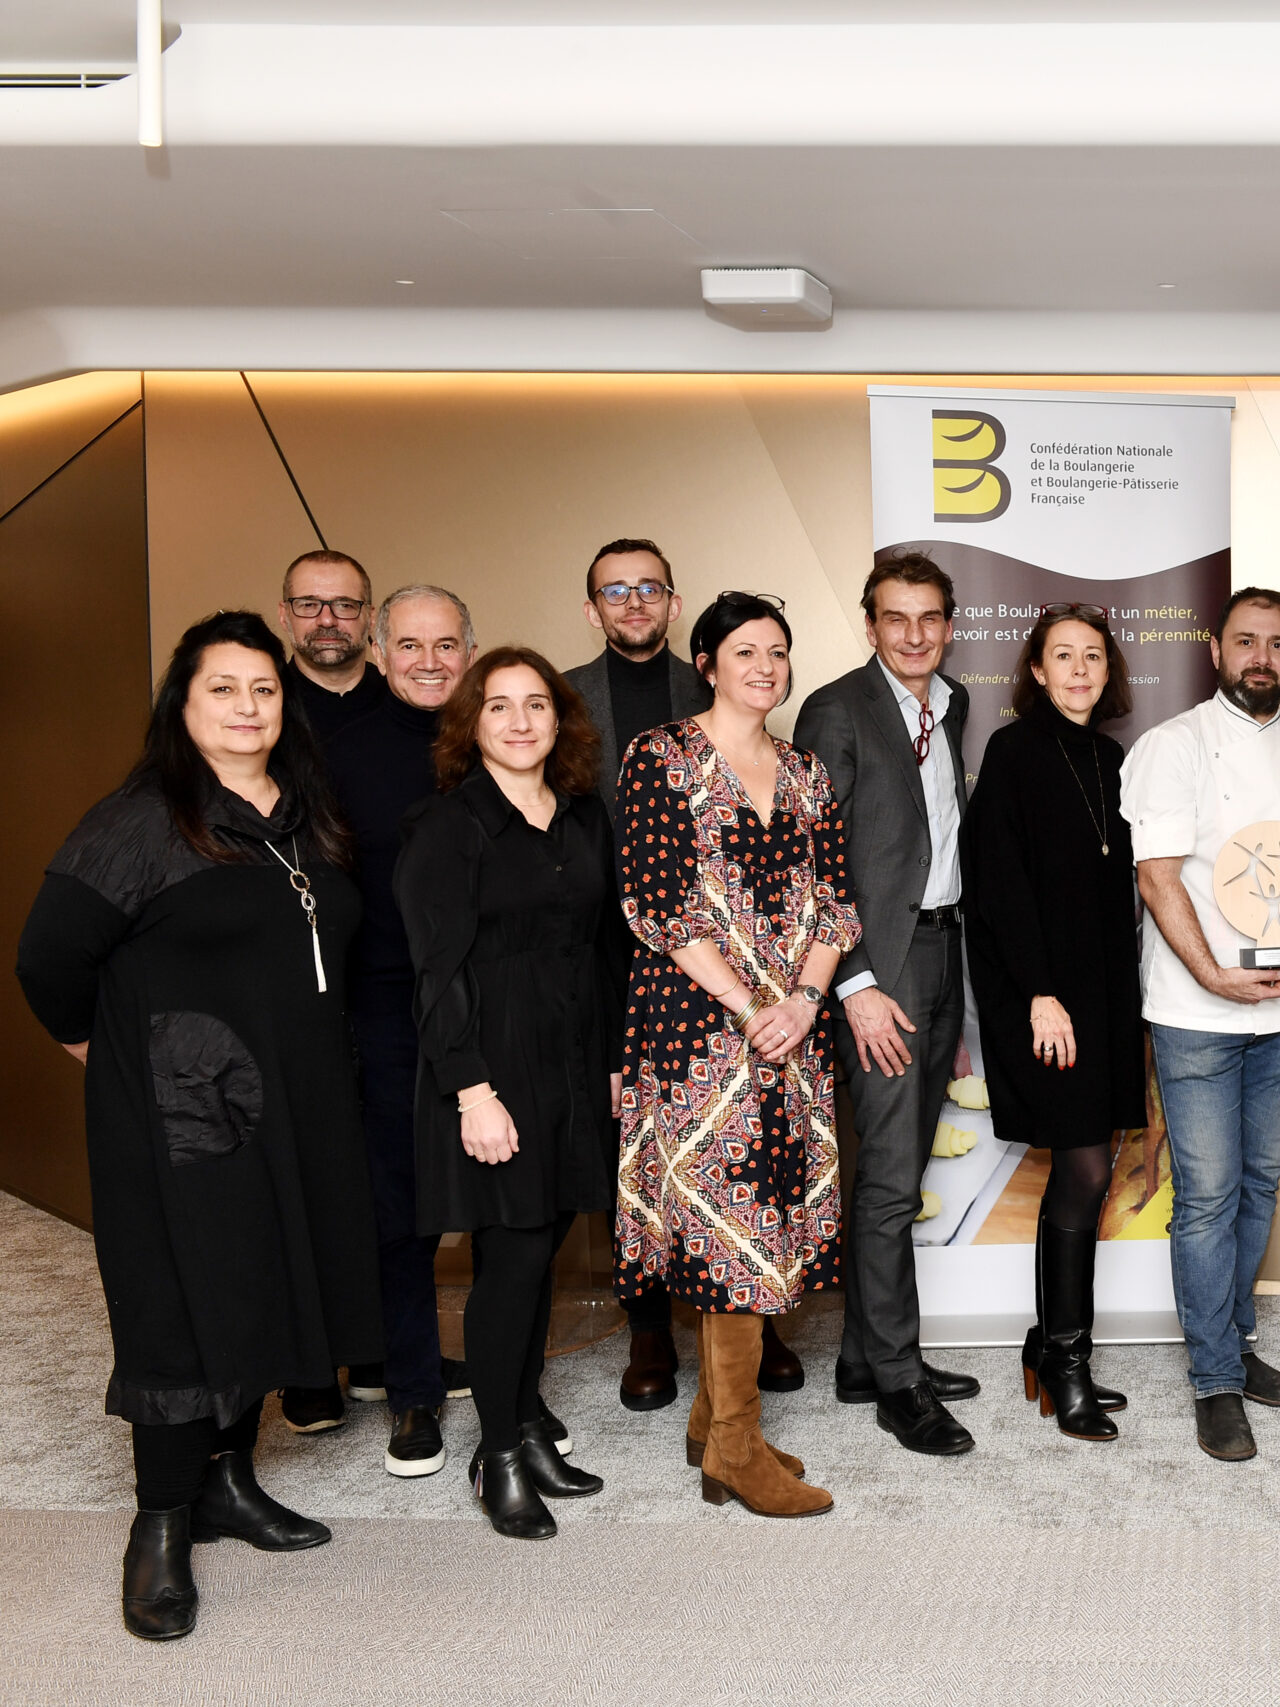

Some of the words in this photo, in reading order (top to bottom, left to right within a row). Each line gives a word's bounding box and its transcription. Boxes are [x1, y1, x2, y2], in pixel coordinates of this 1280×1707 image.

[1030, 442, 1113, 456] Confédération
[1116, 445, 1173, 457] Nationale
[1030, 458, 1045, 471] de
[1049, 459, 1060, 471] la
[1064, 460, 1135, 475] Boulangerie
[1030, 477, 1042, 487] et
[1046, 476, 1179, 491] Boulangerie-Pâtisserie
[1031, 492, 1085, 506] Française
[965, 606, 993, 621] que
[1121, 609, 1140, 619] un
[1144, 605, 1197, 621] métier,
[953, 627, 989, 640] evoir
[995, 628, 1019, 640] est
[1121, 628, 1135, 641] la
[1140, 628, 1211, 645] pérennité
[960, 673, 1010, 684] Défendre
[1127, 674, 1160, 685] ession
